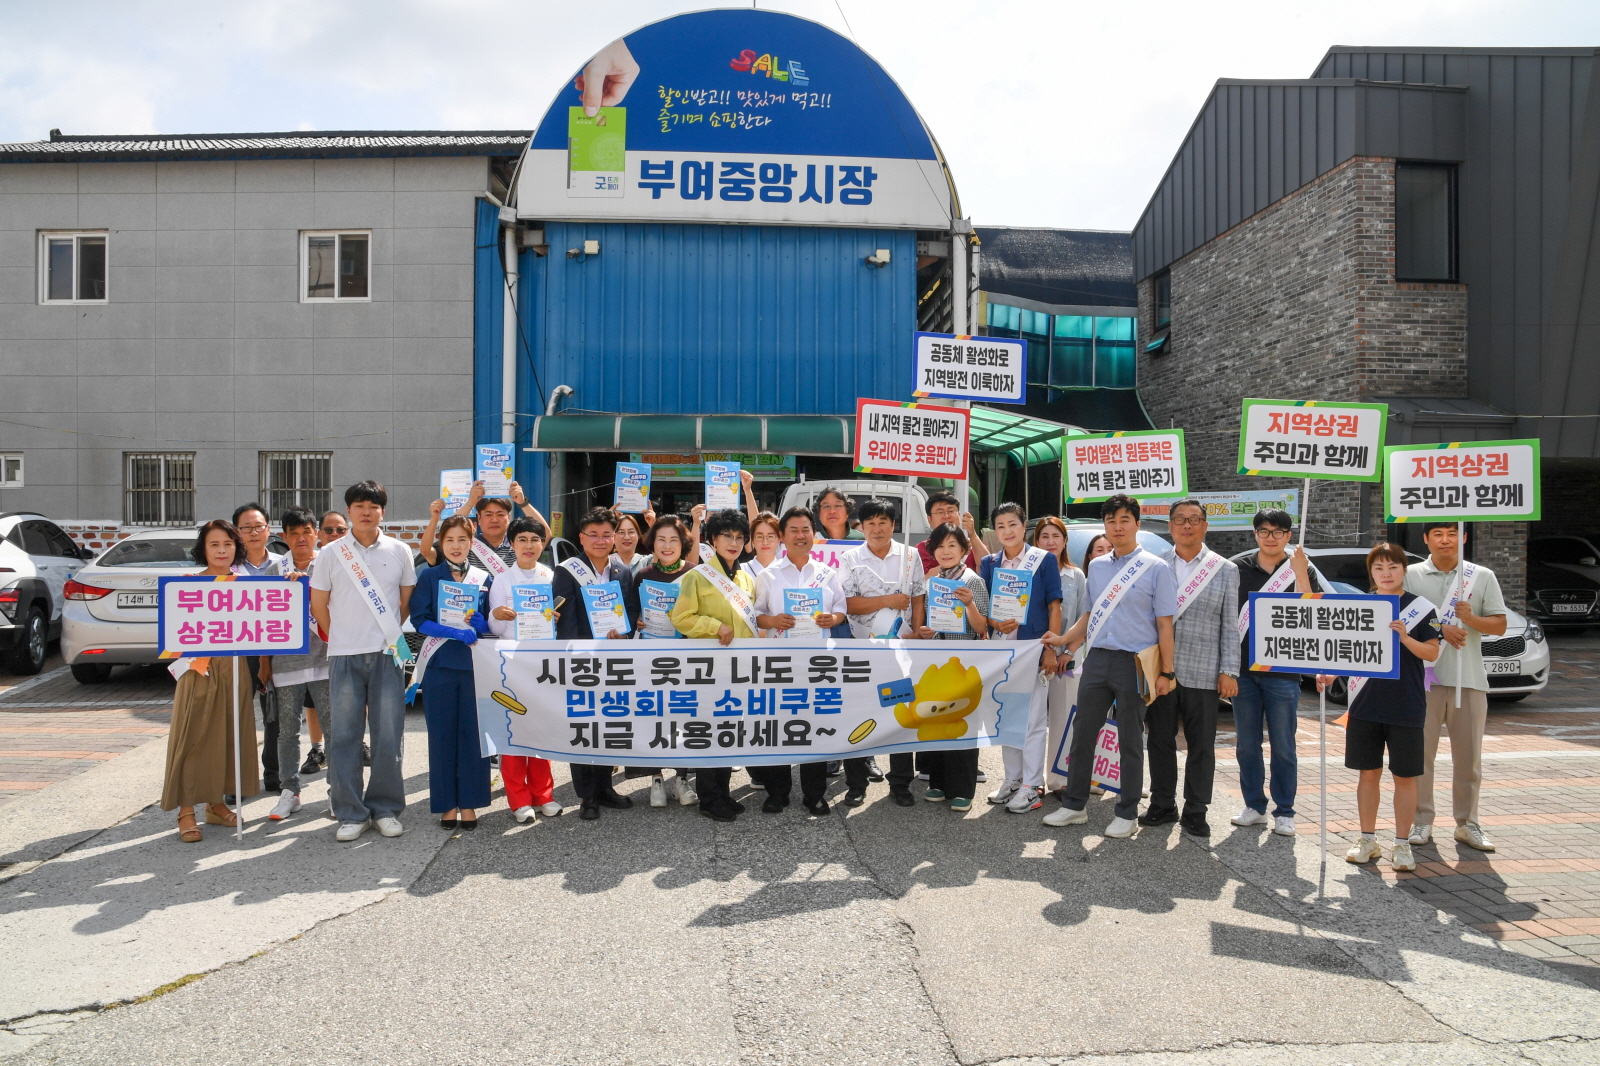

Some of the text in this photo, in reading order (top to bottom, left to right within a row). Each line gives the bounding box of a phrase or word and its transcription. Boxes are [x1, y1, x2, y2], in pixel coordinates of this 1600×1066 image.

[730, 49, 810, 86] SALE
[658, 85, 832, 110] 할인받고!! 맛있게 먹고!!
[658, 110, 773, 133] 즐기며 쇼핑한다
[638, 159, 878, 206] 부여중앙시장
[930, 343, 1010, 368] 공동체 활성화로
[924, 368, 1014, 393] 지역발전 이룩하자
[869, 413, 958, 440] 내 지역 물건 팔아주기
[1268, 412, 1359, 438] 지역상권
[868, 440, 958, 466] 우리이웃 웃음핀다
[1075, 440, 1173, 465] 부여발전 원동력은
[1253, 441, 1368, 469] 주민과 함께
[1411, 453, 1509, 478] 지역상권
[1076, 467, 1174, 492] 지역 물건 팔아주기
[1231, 502, 1257, 514] 환급
[1400, 483, 1524, 510] 주민과 함께
[569, 561, 588, 576] 지역
[124, 595, 144, 604] 14버
[177, 589, 292, 614] 부여사랑
[1271, 606, 1374, 632] 공동체 활성화로
[177, 620, 292, 646] 상권사랑
[1264, 636, 1383, 664] 지역발전 이룩하자
[536, 654, 872, 686] 시장도 웃고 나도 웃는
[1492, 662, 1515, 672] 2890
[566, 687, 844, 718] 민생회복 소비쿠폰
[569, 720, 837, 750] 지금 사용하세요~
